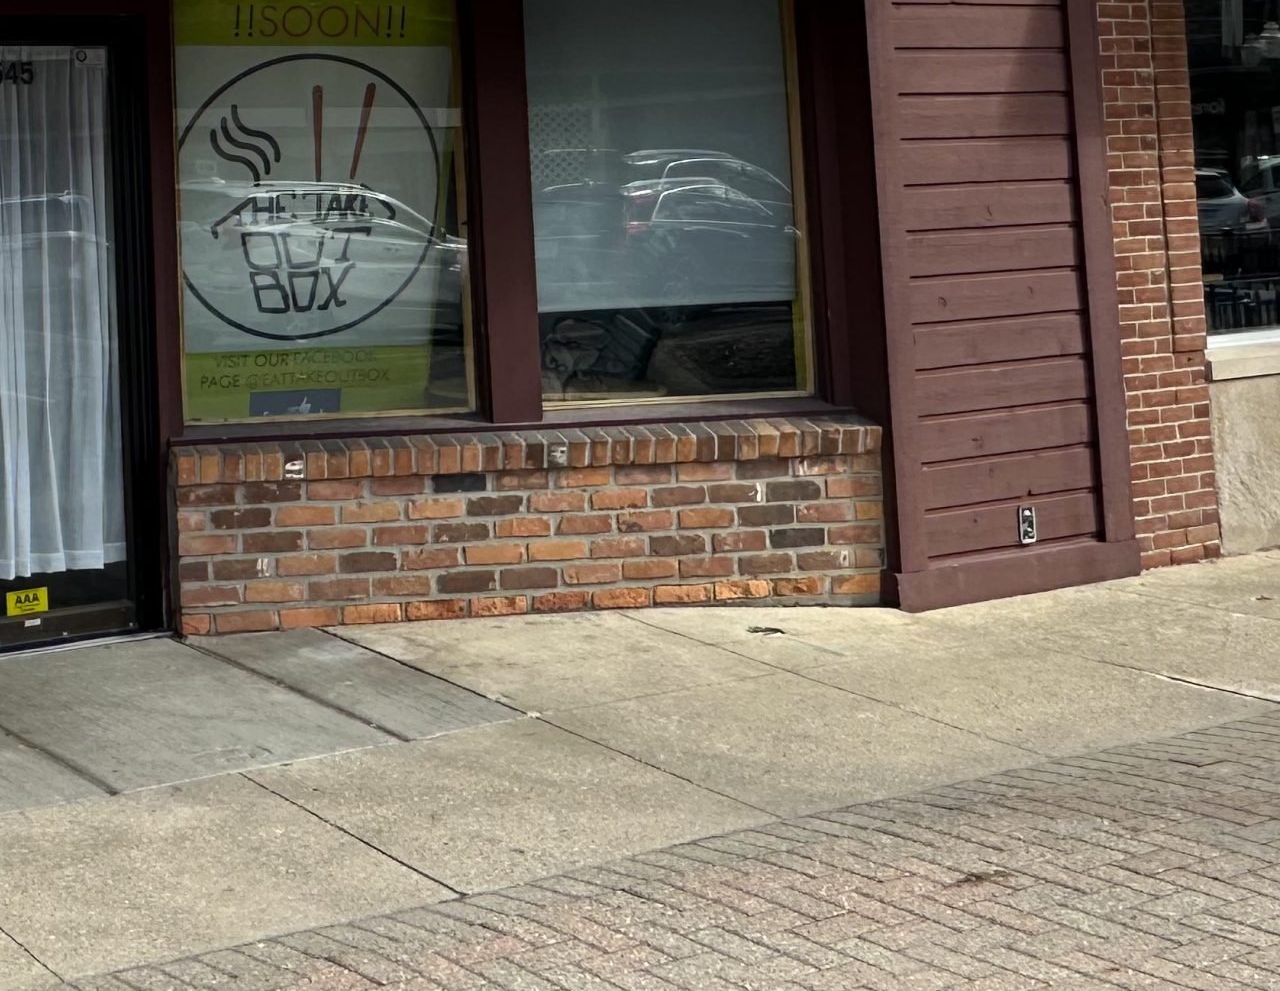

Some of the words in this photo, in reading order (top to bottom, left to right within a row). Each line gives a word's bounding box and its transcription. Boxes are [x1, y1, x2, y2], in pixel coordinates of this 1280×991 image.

[234, 3, 407, 39] !!SOON!!
[249, 261, 356, 314] BOX
[254, 352, 290, 368] OUR
[200, 373, 241, 390] PAGE
[15, 592, 40, 604] AAA
